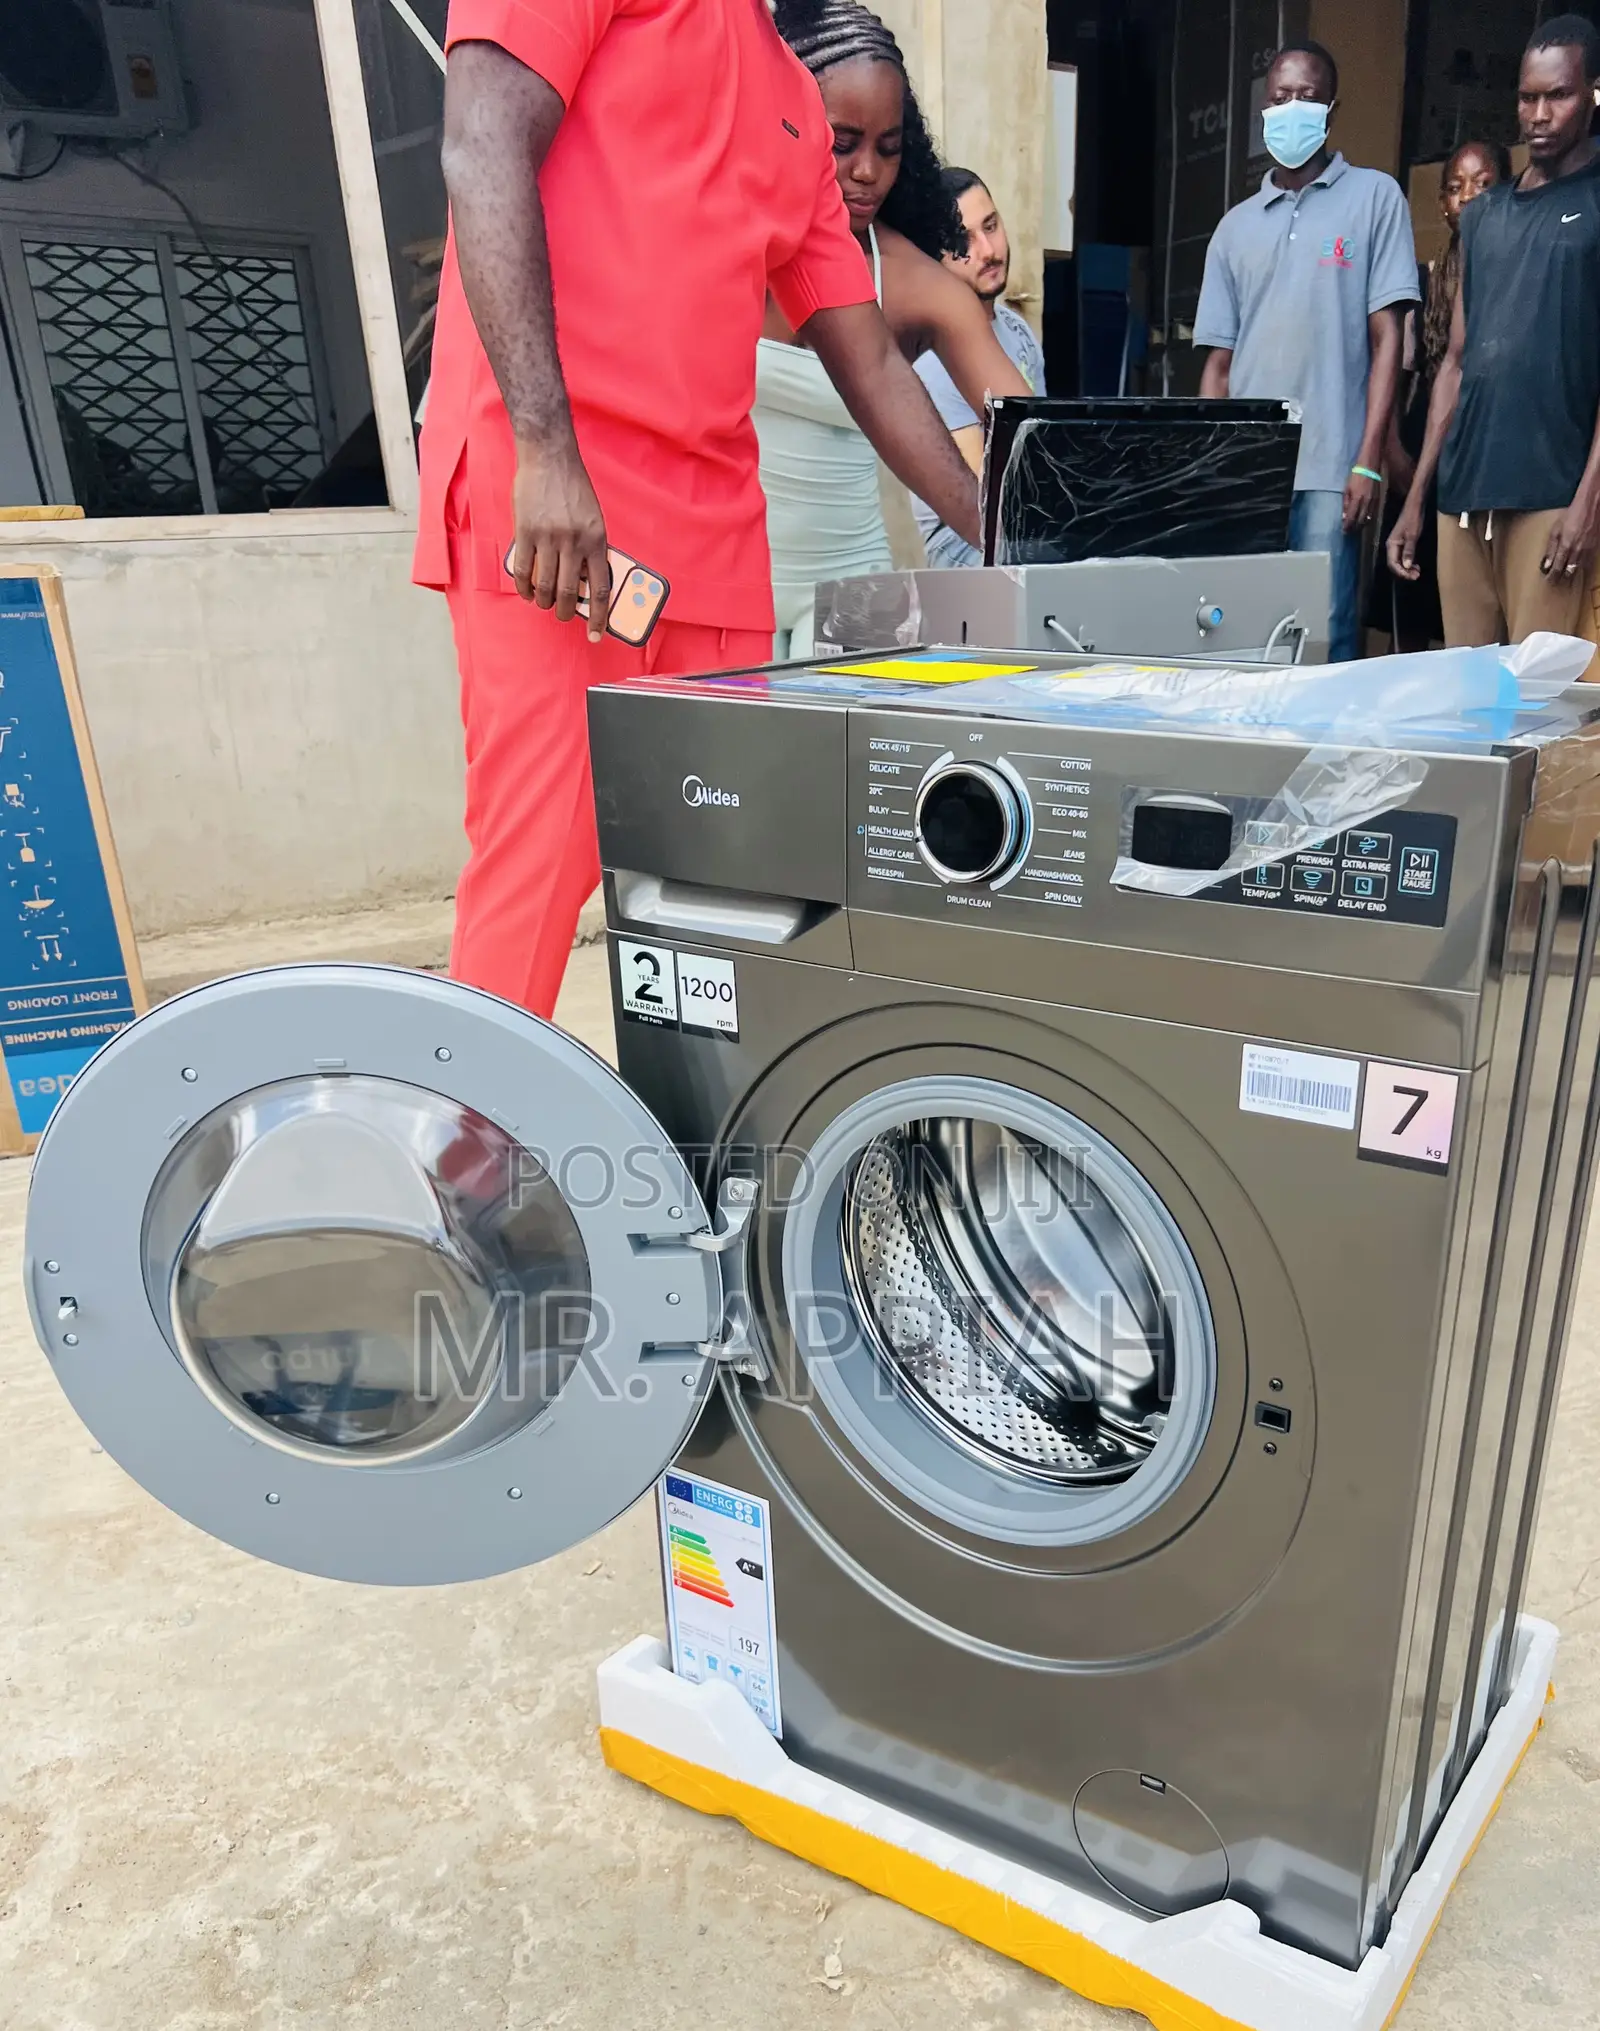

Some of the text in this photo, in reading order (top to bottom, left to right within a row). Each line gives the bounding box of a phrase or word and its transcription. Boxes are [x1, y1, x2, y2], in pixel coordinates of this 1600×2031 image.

[969, 733, 984, 742] OFF
[869, 741, 890, 751] QUICK
[869, 764, 901, 775] DELICATE
[1060, 760, 1092, 771] COTTON
[682, 774, 740, 807] Midea
[1044, 782, 1090, 795] SYNTHETICS
[868, 805, 890, 816] BULKY
[1052, 807, 1089, 819] ECO 40-60
[867, 825, 914, 838] HEALTH GUARD
[1072, 829, 1087, 839] MIX
[867, 846, 915, 860] ALLERGY CARE
[1063, 849, 1086, 860] JEANS
[1296, 854, 1334, 866] PREWASH
[1341, 859, 1391, 873] EXTRA RINSE
[867, 866, 905, 879] RINSE&SPIN
[1024, 867, 1084, 883] HANDWASH/WOOL
[1404, 868, 1432, 879] START
[1402, 879, 1432, 890] PAUSE
[946, 894, 992, 909] DRUM CLEAN
[1044, 891, 1083, 904] SPIN ONLY
[1337, 899, 1387, 912] DELAY END
[633, 951, 664, 1005] 2
[637, 974, 660, 984] YEARS
[681, 976, 733, 1003] 1200
[7, 989, 118, 1011] FRONT LOADING
[624, 998, 675, 1017] WARRANTY
[649, 1016, 663, 1025] Parts
[716, 1019, 734, 1029] rpm
[4, 1029, 68, 1045] MACHINE
[1391, 1084, 1429, 1136] 7
[1425, 1146, 1442, 1160] kg
[696, 1488, 733, 1511] ENERG
[738, 1636, 760, 1656] 197
